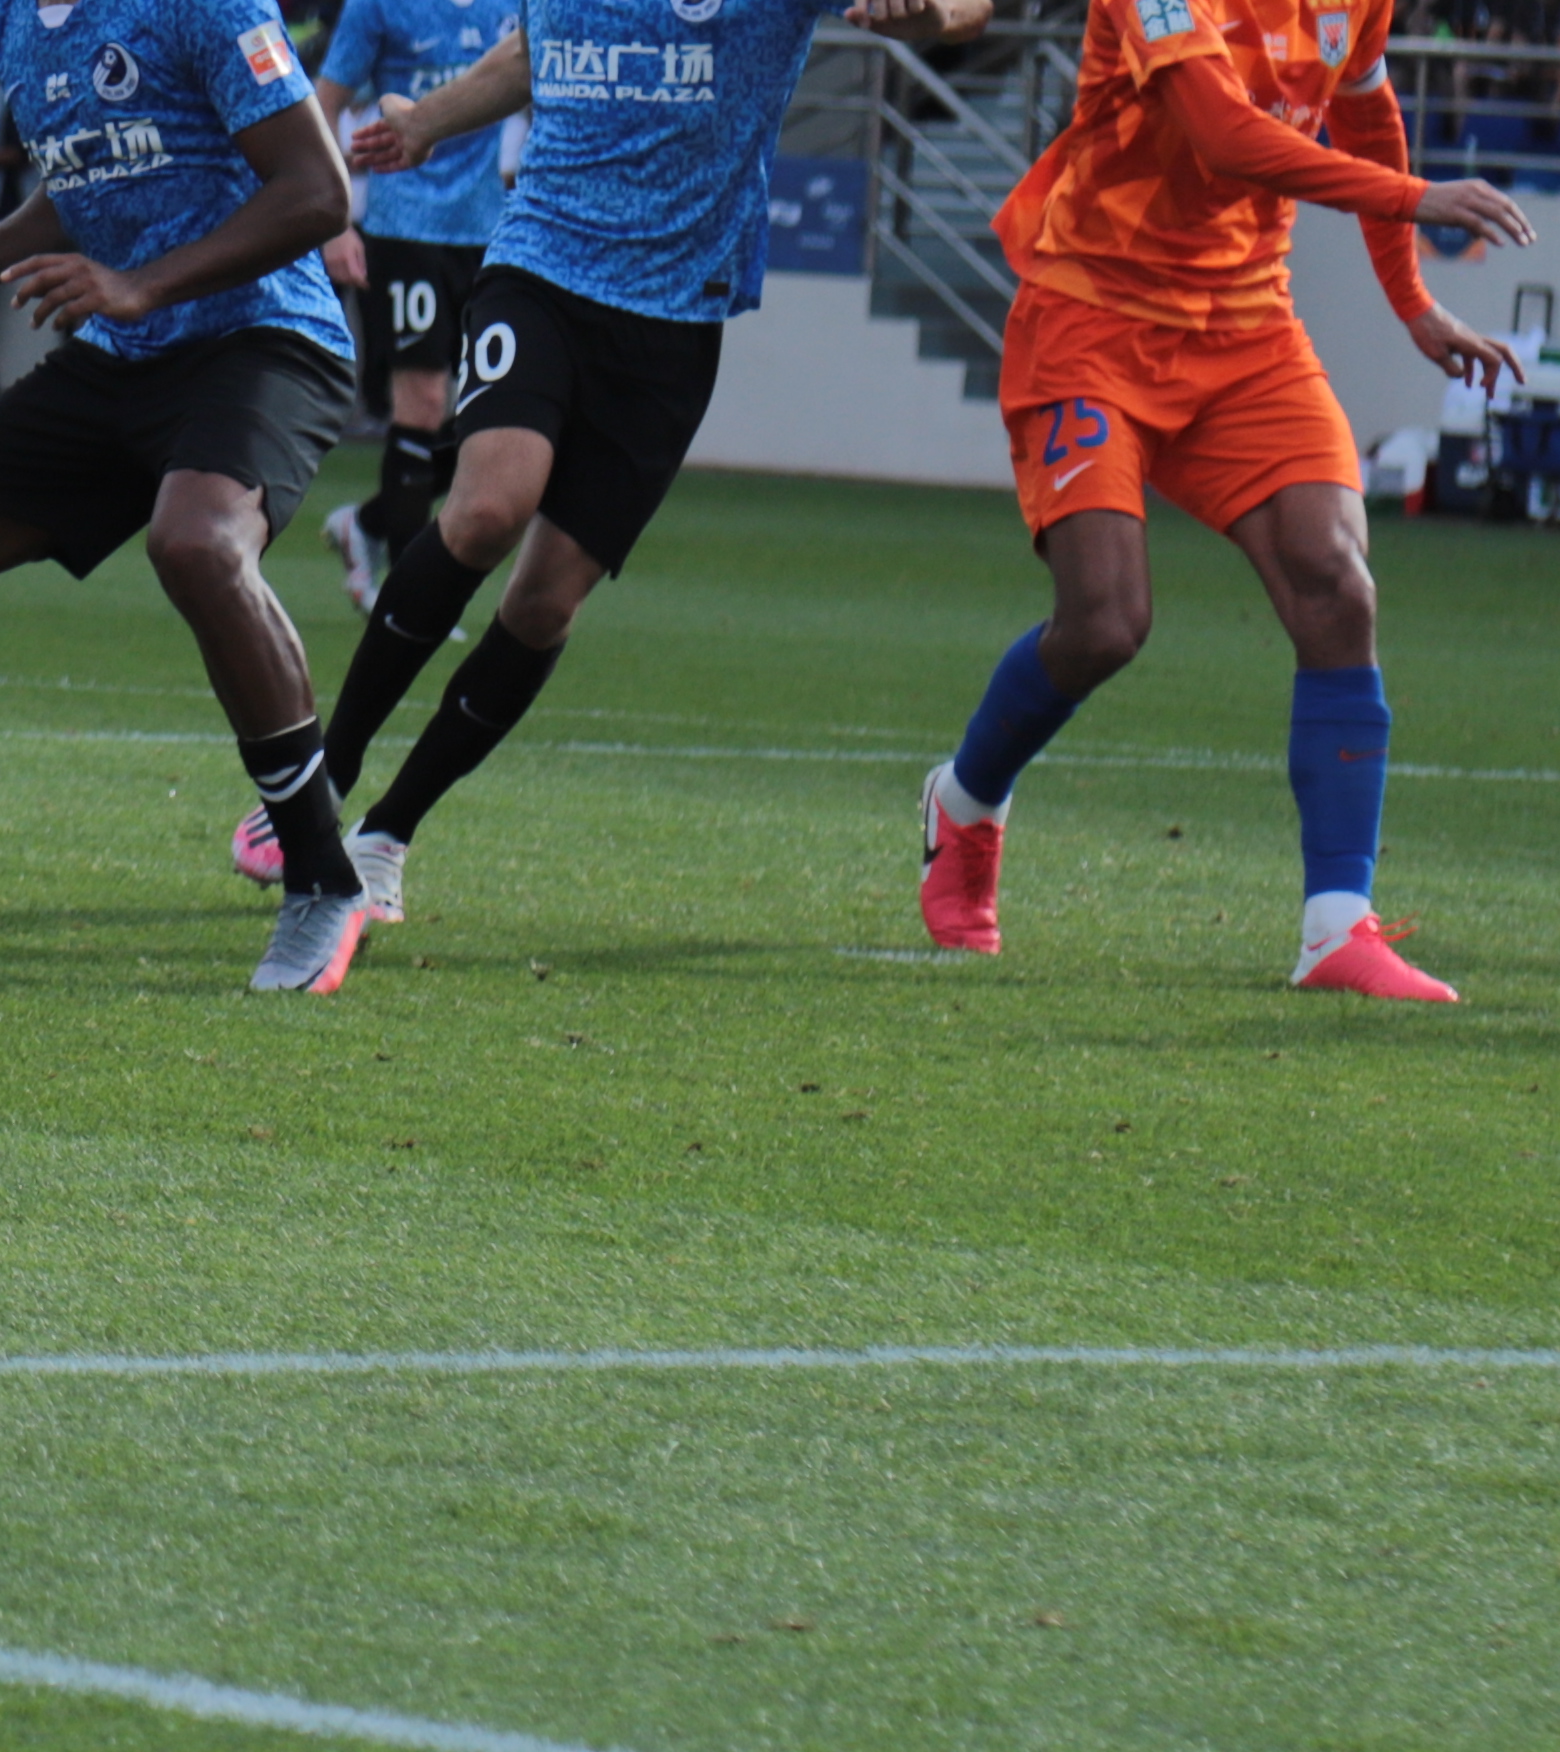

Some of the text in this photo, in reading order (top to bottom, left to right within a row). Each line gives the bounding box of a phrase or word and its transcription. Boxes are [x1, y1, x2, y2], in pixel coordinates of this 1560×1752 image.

[538, 39, 714, 84] 万达广场
[538, 82, 716, 103] WANDA PLAZA
[88, 152, 174, 184] PLAZA
[387, 279, 437, 333] 10
[1038, 397, 1110, 466] 25
